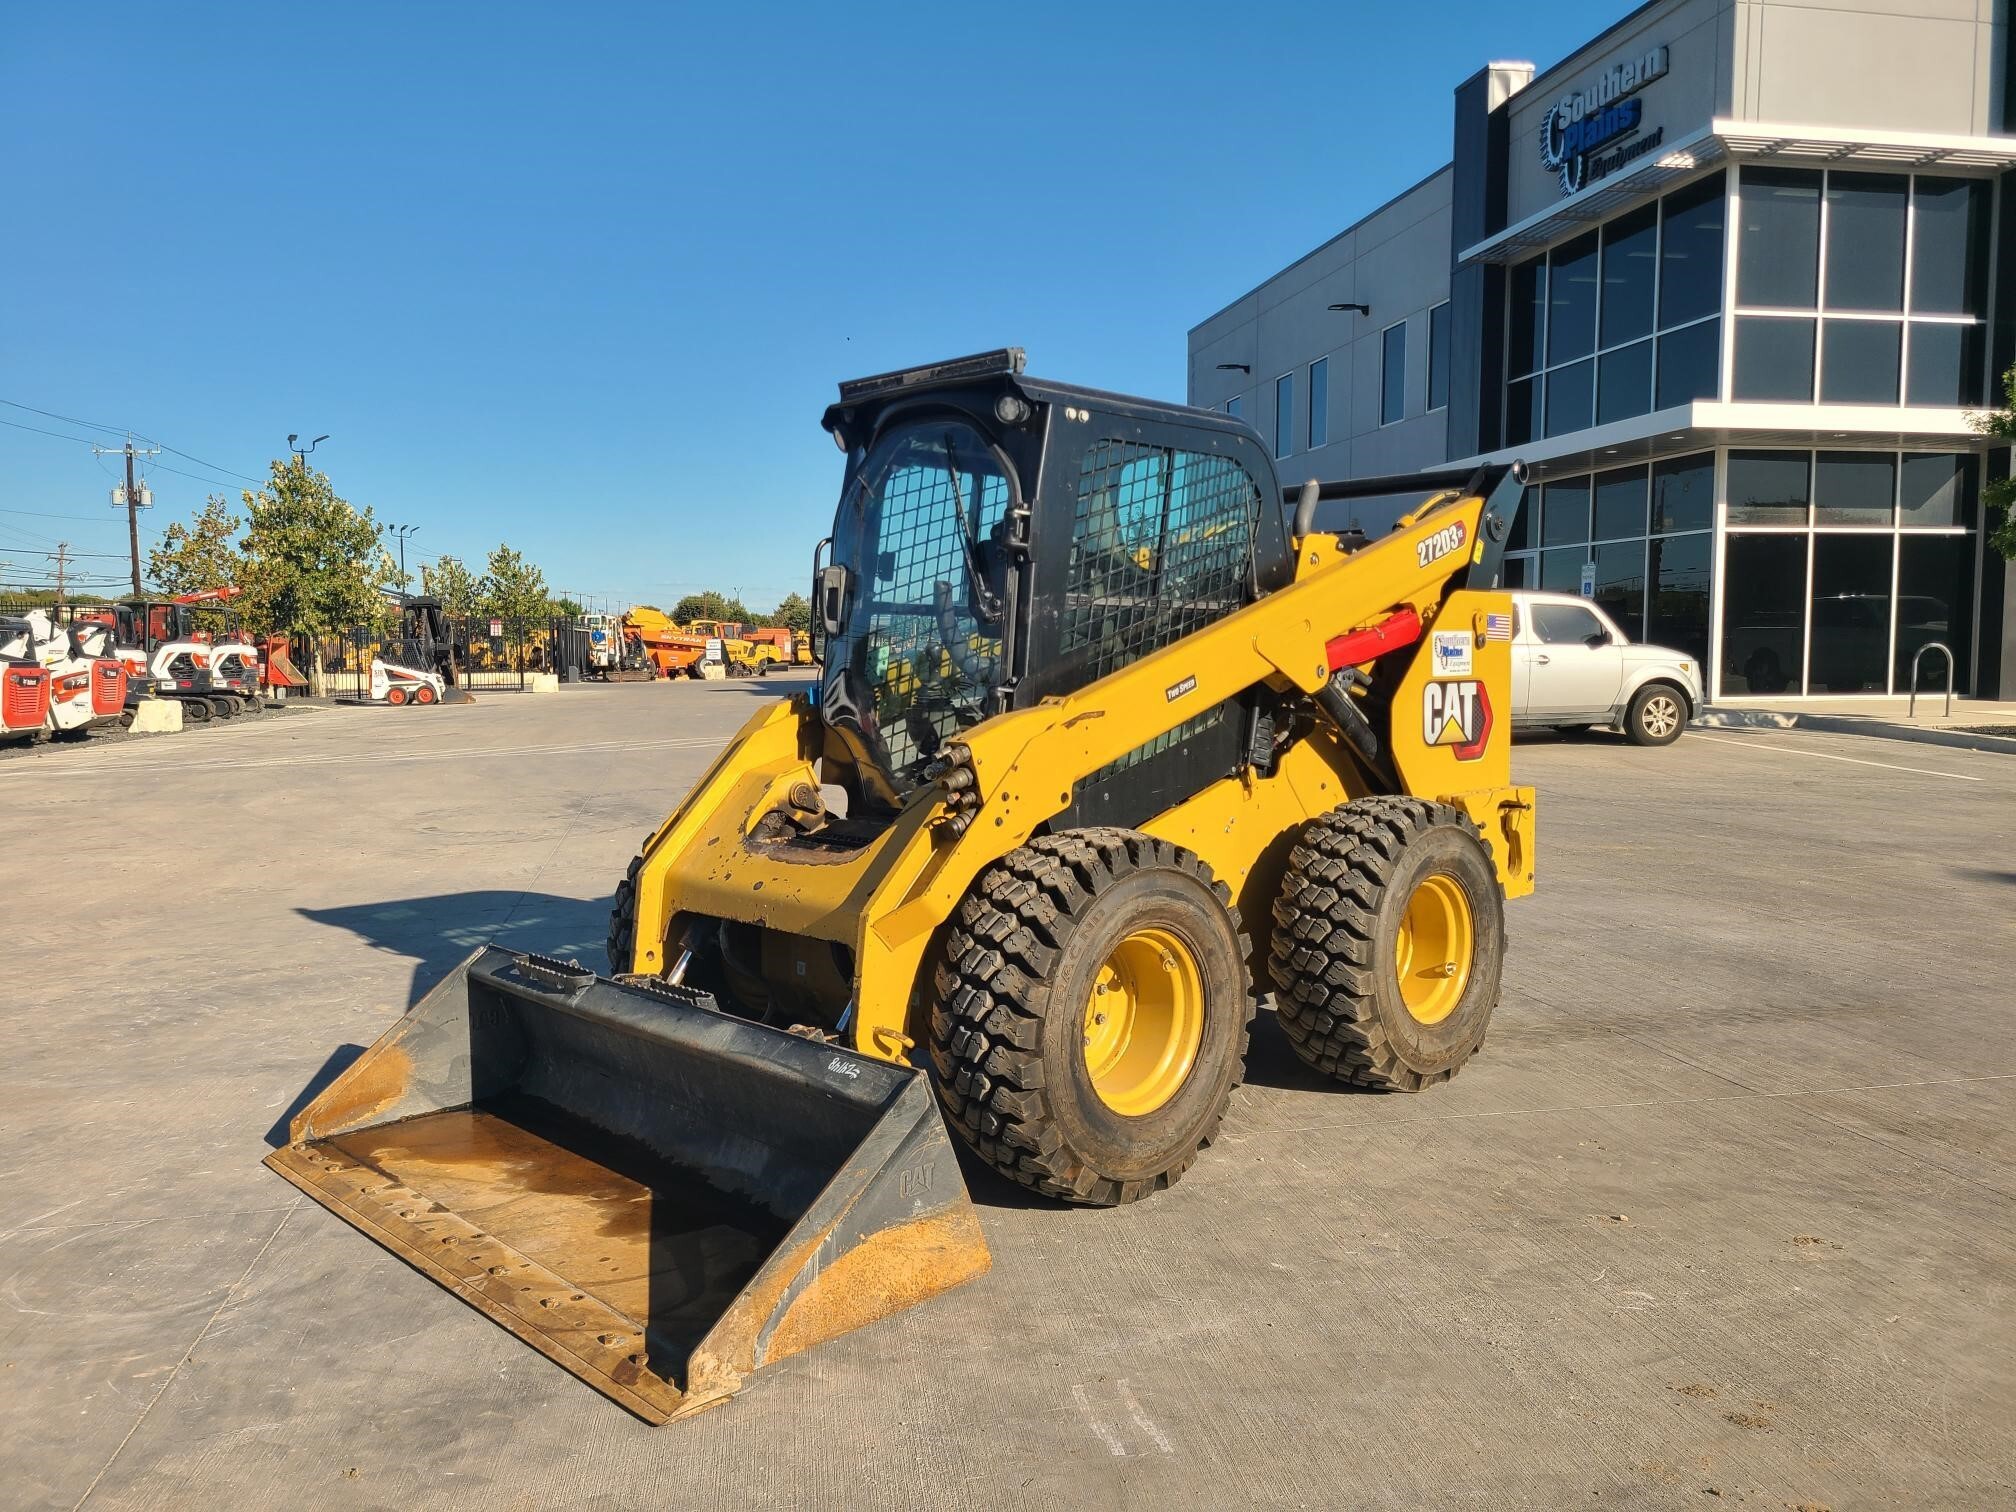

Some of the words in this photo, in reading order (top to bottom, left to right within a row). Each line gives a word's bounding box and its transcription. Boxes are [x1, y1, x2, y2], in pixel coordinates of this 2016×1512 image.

[1558, 47, 1668, 130] Southern
[1417, 524, 1459, 567] 272D3
[1423, 682, 1477, 745] CAT
[899, 1161, 936, 1199] CAT
